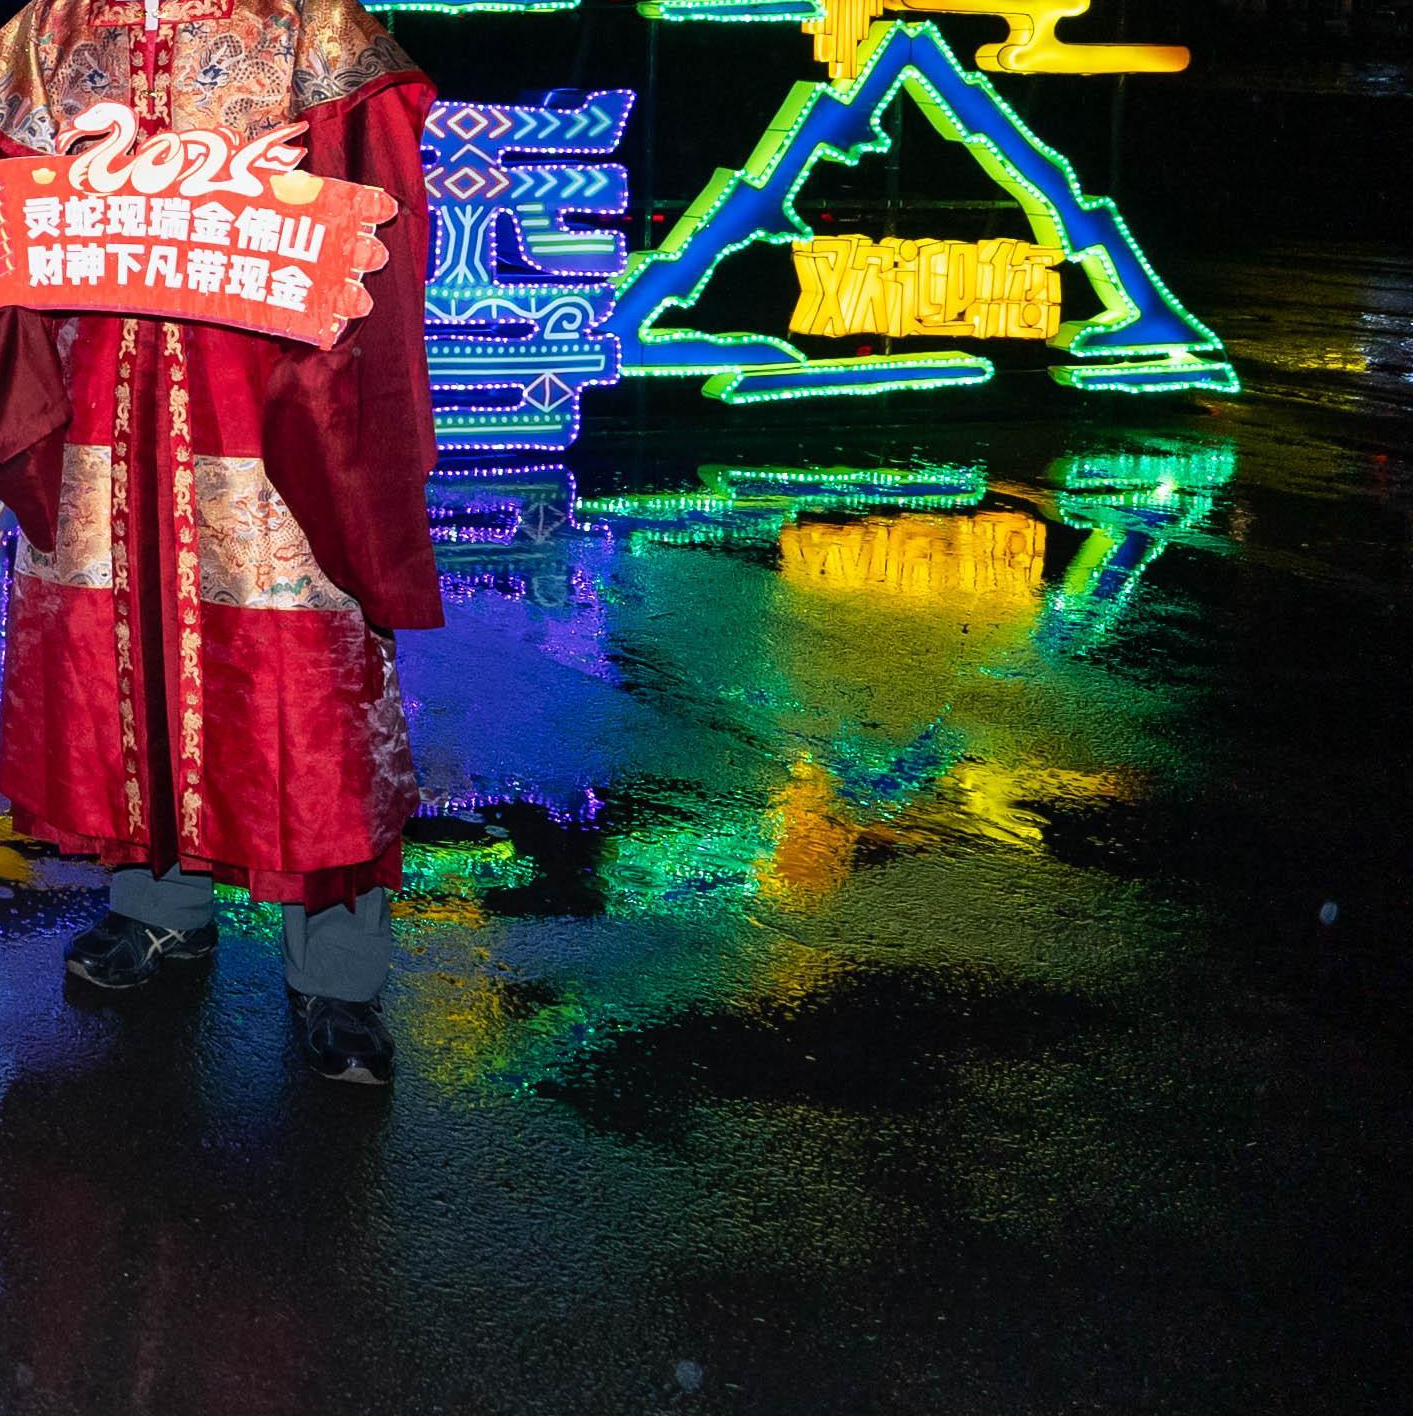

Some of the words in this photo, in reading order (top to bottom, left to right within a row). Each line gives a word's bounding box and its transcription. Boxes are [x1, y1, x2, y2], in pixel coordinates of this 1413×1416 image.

[22, 195, 326, 264] 灵蛇现瑞金佛山
[28, 244, 314, 312] 财神下凡带现金
